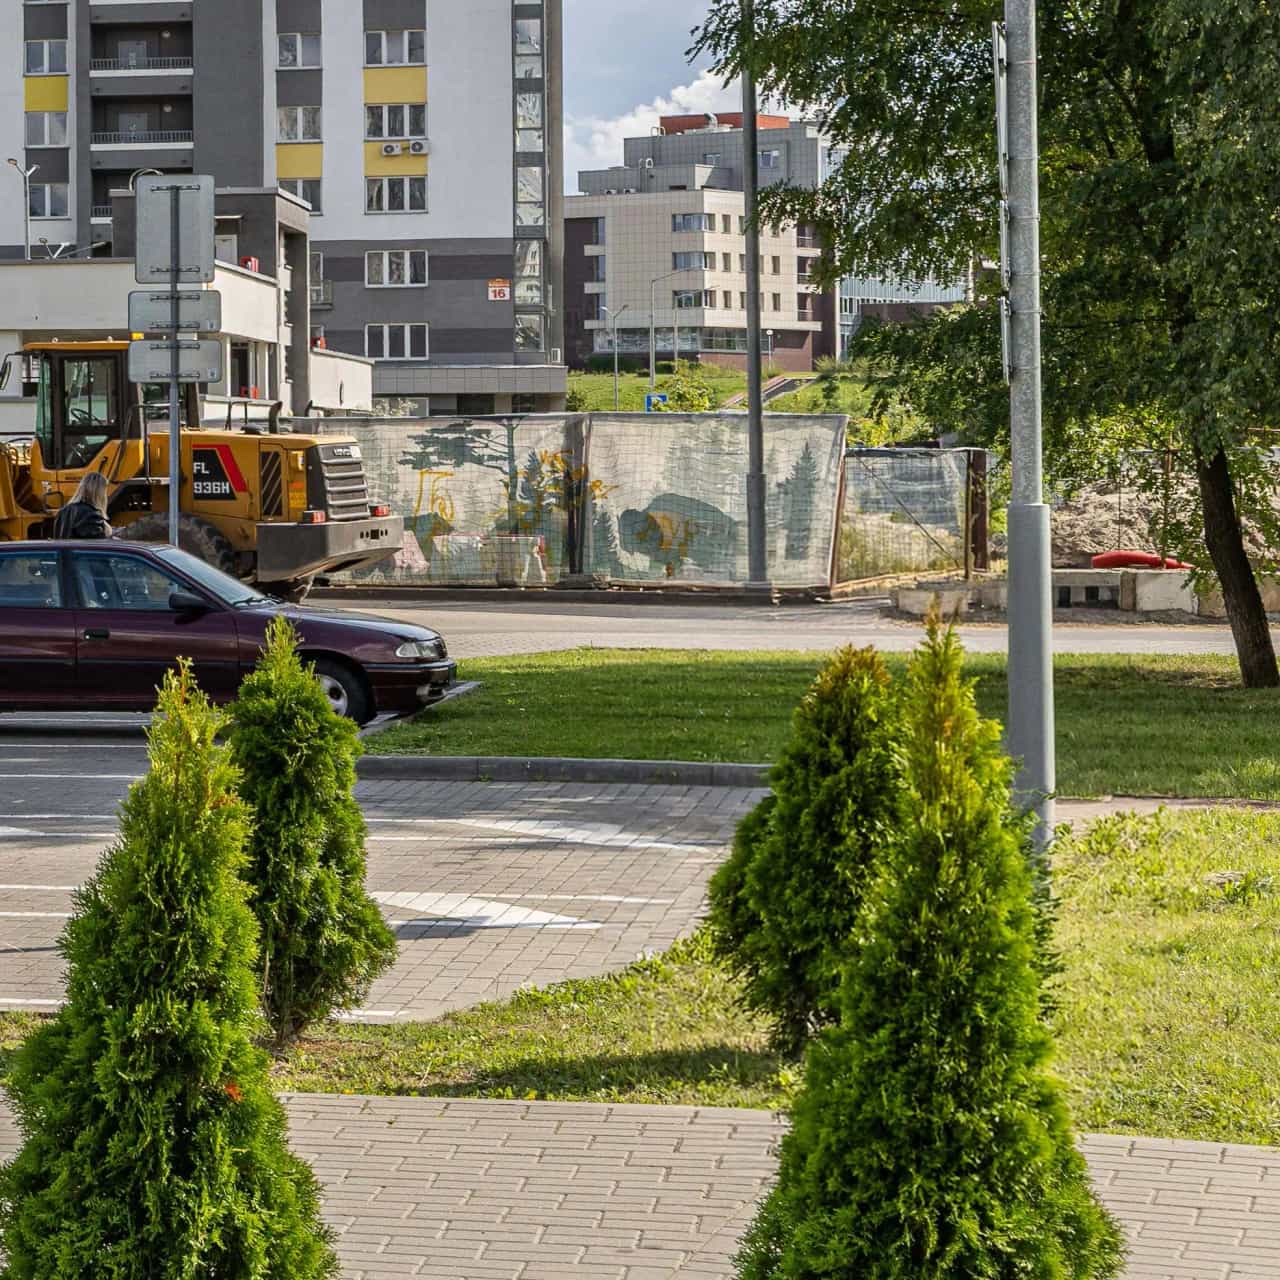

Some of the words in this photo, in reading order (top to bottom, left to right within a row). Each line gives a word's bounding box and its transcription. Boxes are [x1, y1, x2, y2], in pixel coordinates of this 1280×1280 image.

[491, 289, 505, 298] 16
[193, 462, 209, 474] FL
[193, 481, 230, 494] 936H
